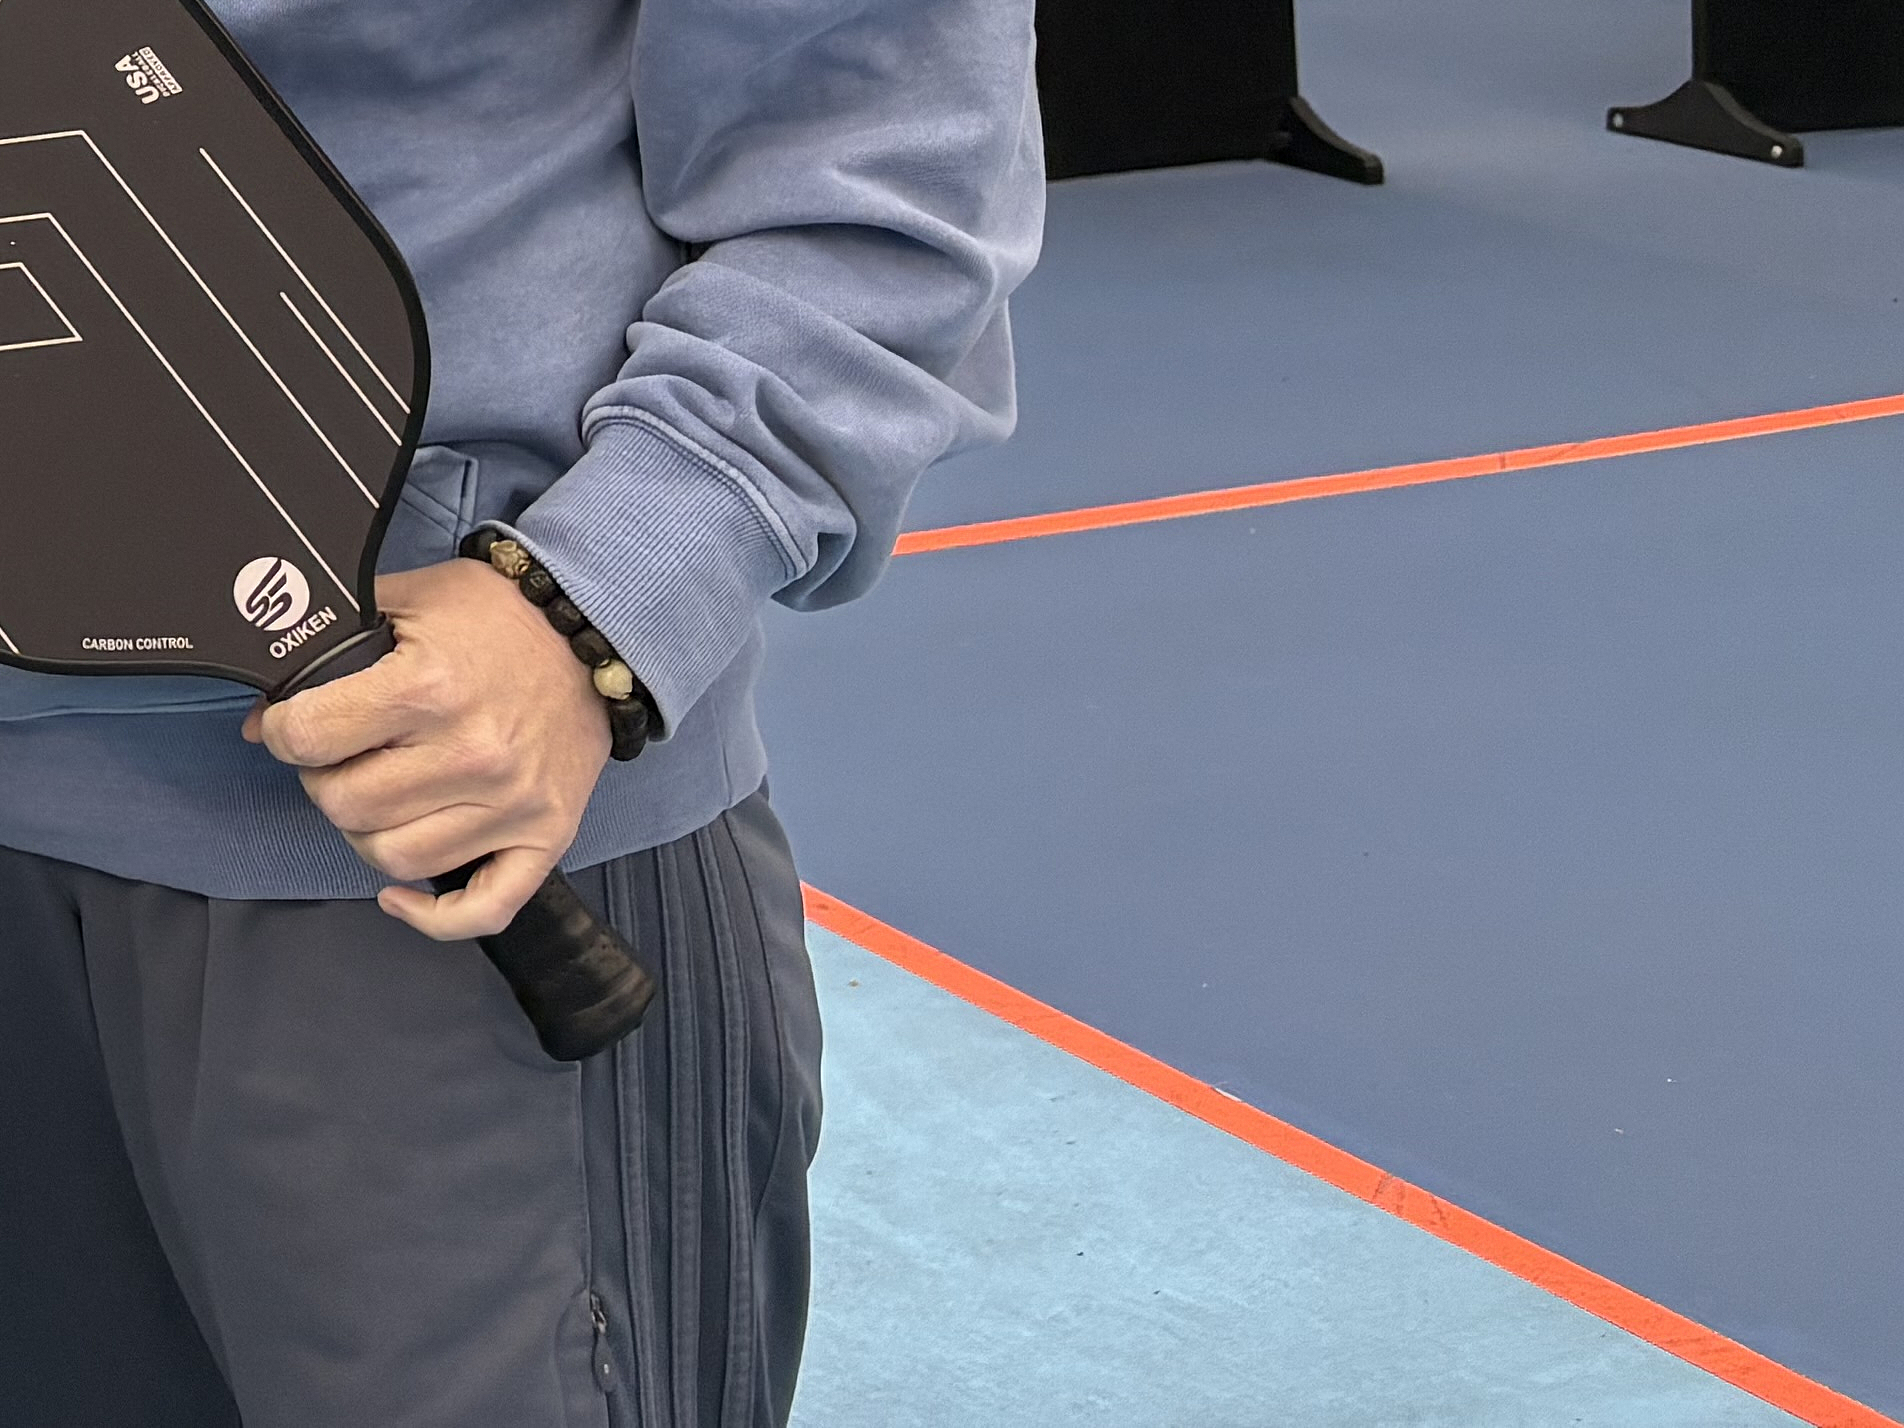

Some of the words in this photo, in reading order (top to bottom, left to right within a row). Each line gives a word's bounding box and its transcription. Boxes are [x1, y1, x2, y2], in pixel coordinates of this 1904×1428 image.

[114, 54, 160, 105] USA
[82, 637, 134, 652] CARBON
[135, 636, 194, 651] CONTROL
[269, 606, 338, 660] OXIKEN
